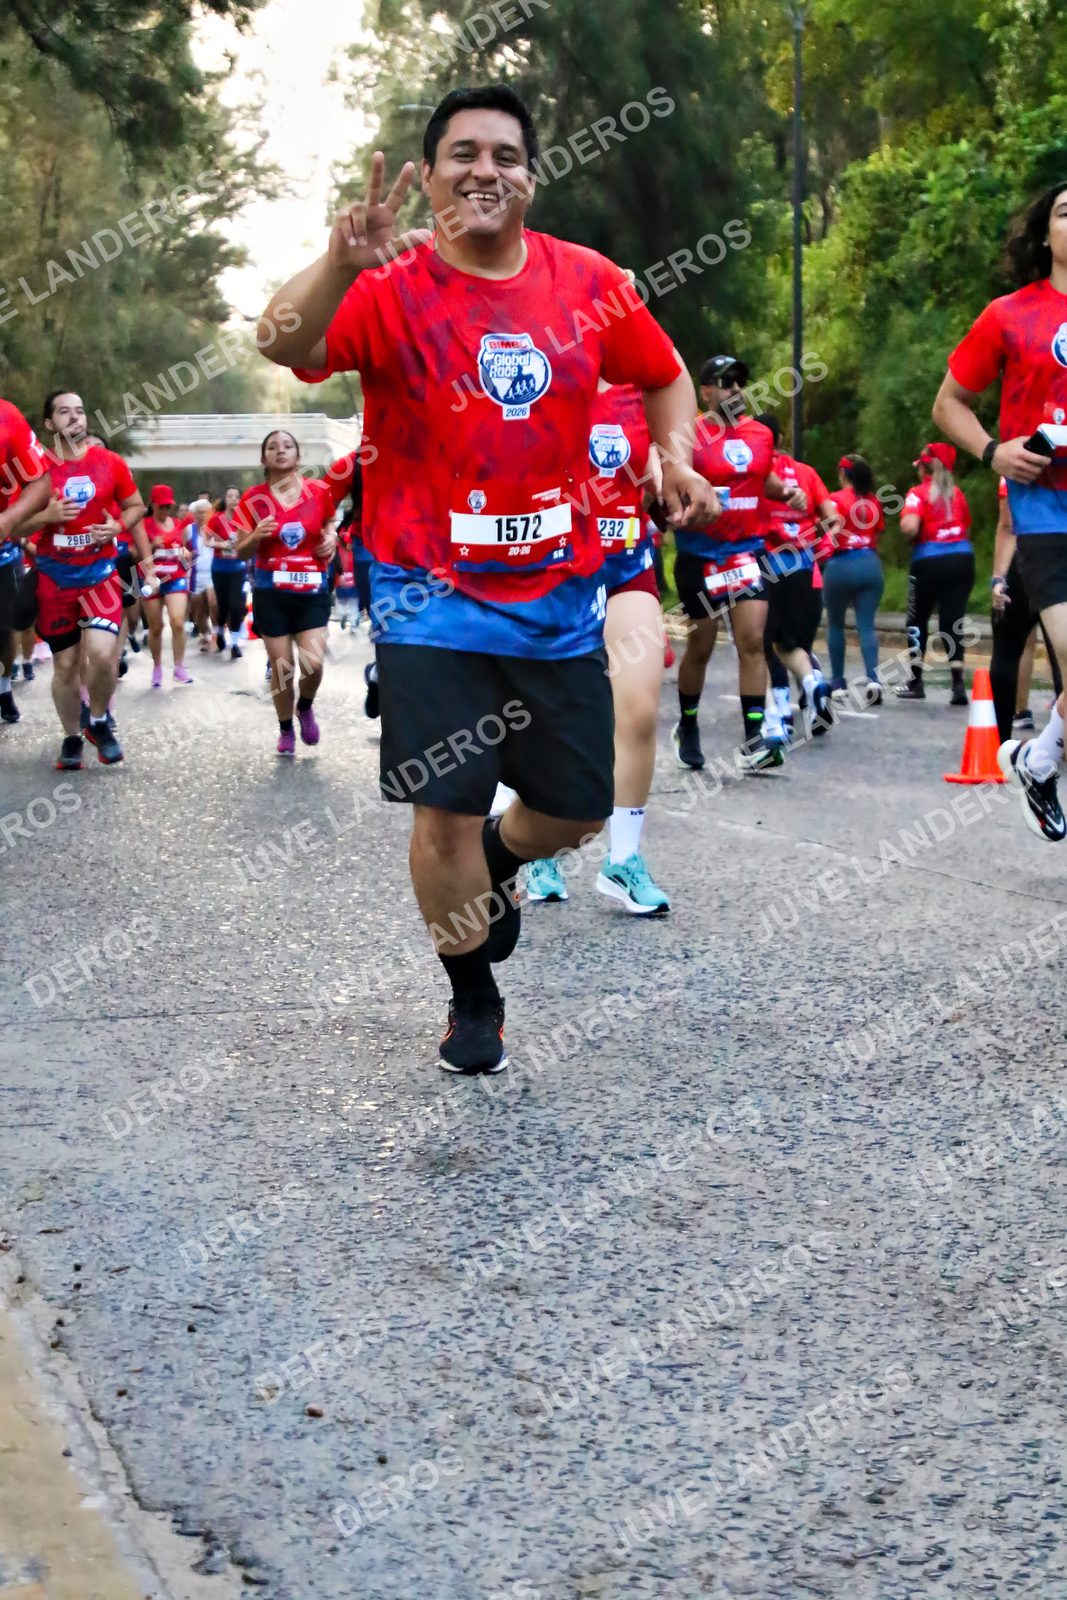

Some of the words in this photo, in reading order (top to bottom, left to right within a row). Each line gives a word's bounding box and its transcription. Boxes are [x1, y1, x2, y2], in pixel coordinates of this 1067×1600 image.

[488, 340, 528, 349] BIMBO
[494, 354, 530, 366] Global
[489, 366, 518, 378] Race
[506, 407, 527, 417] 2026
[495, 514, 542, 542] 1572
[553, 548, 564, 559] 5K
